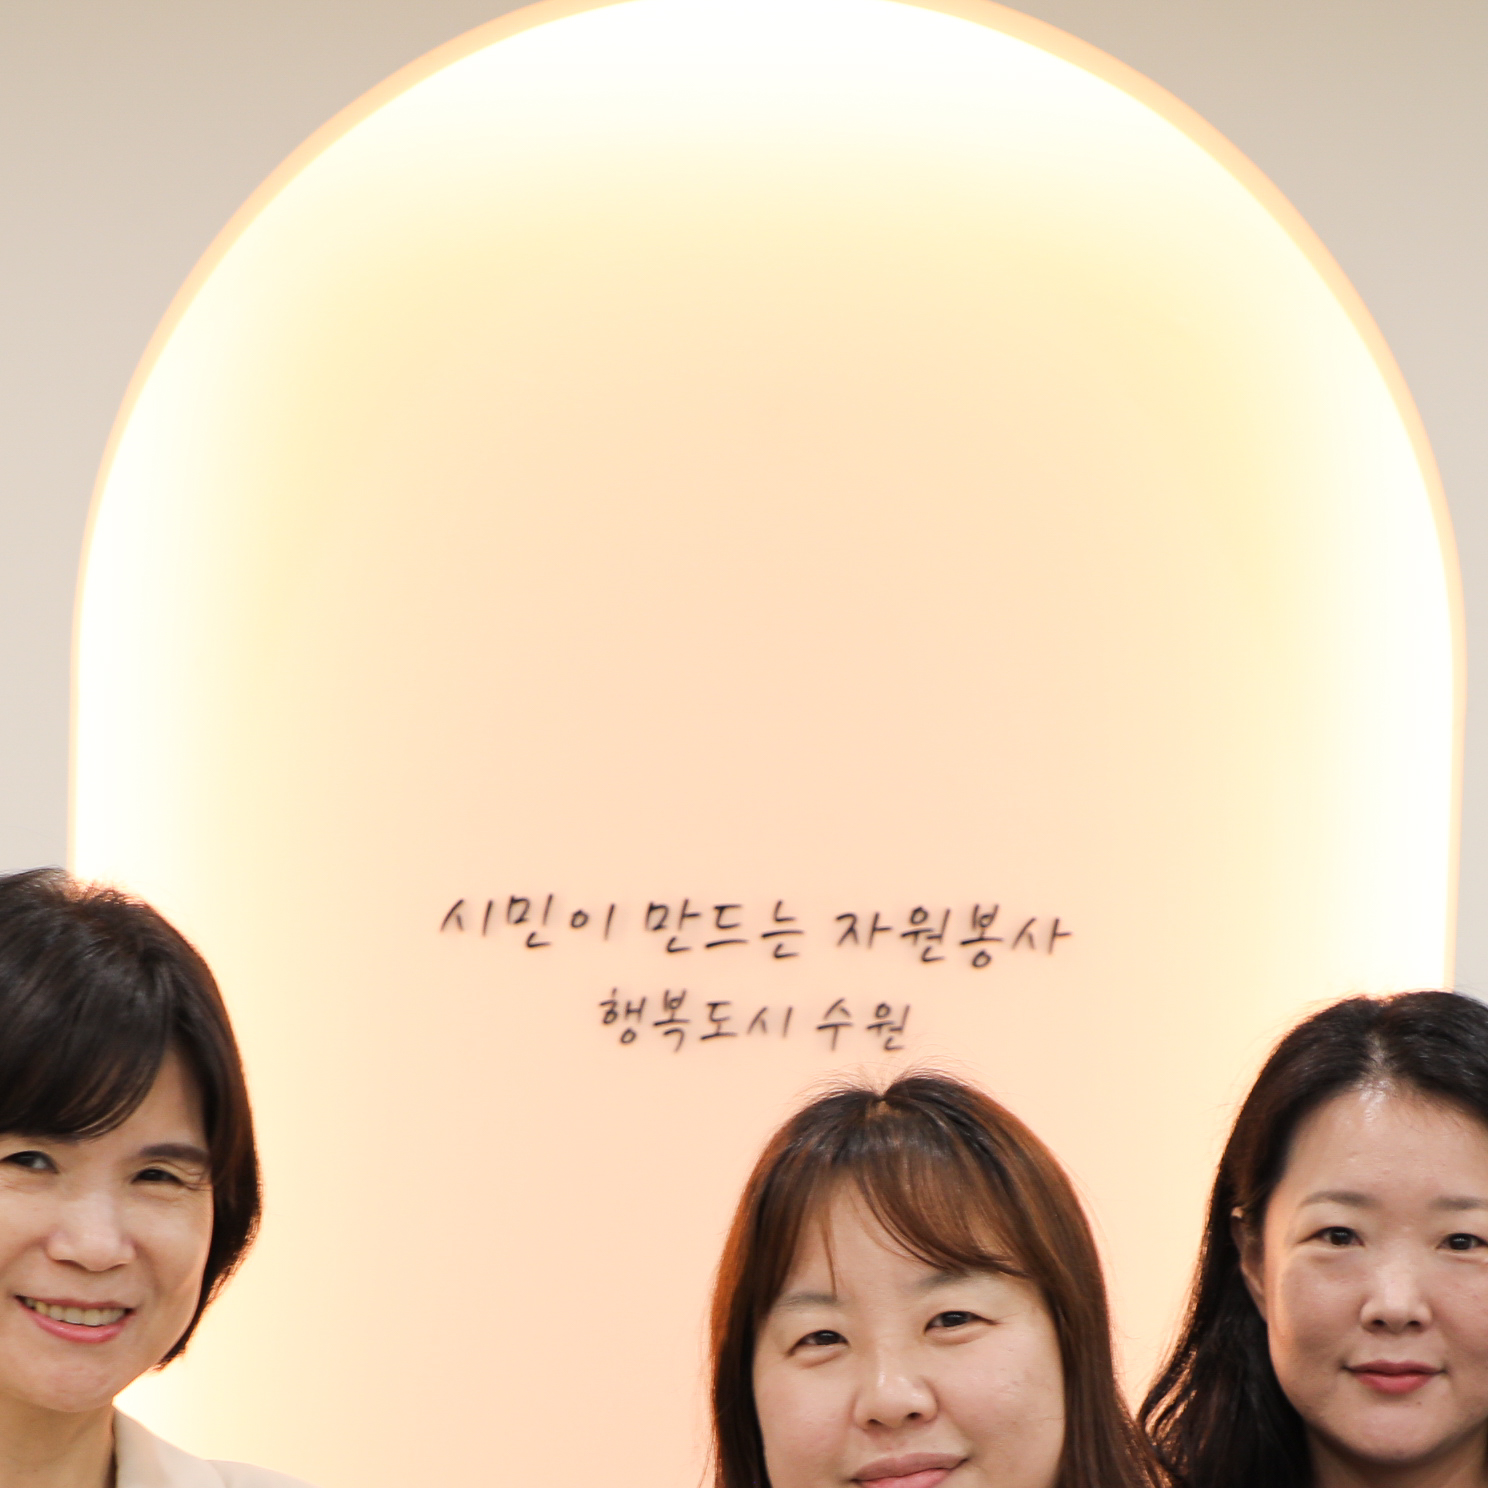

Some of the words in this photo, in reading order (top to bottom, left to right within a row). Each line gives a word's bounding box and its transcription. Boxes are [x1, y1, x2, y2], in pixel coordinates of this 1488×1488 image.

[440, 893, 616, 949] 시민이
[645, 898, 805, 960] 만드는
[835, 902, 1072, 969] 자원봉사
[598, 986, 793, 1052] 행복도시
[814, 997, 911, 1052] 수원
